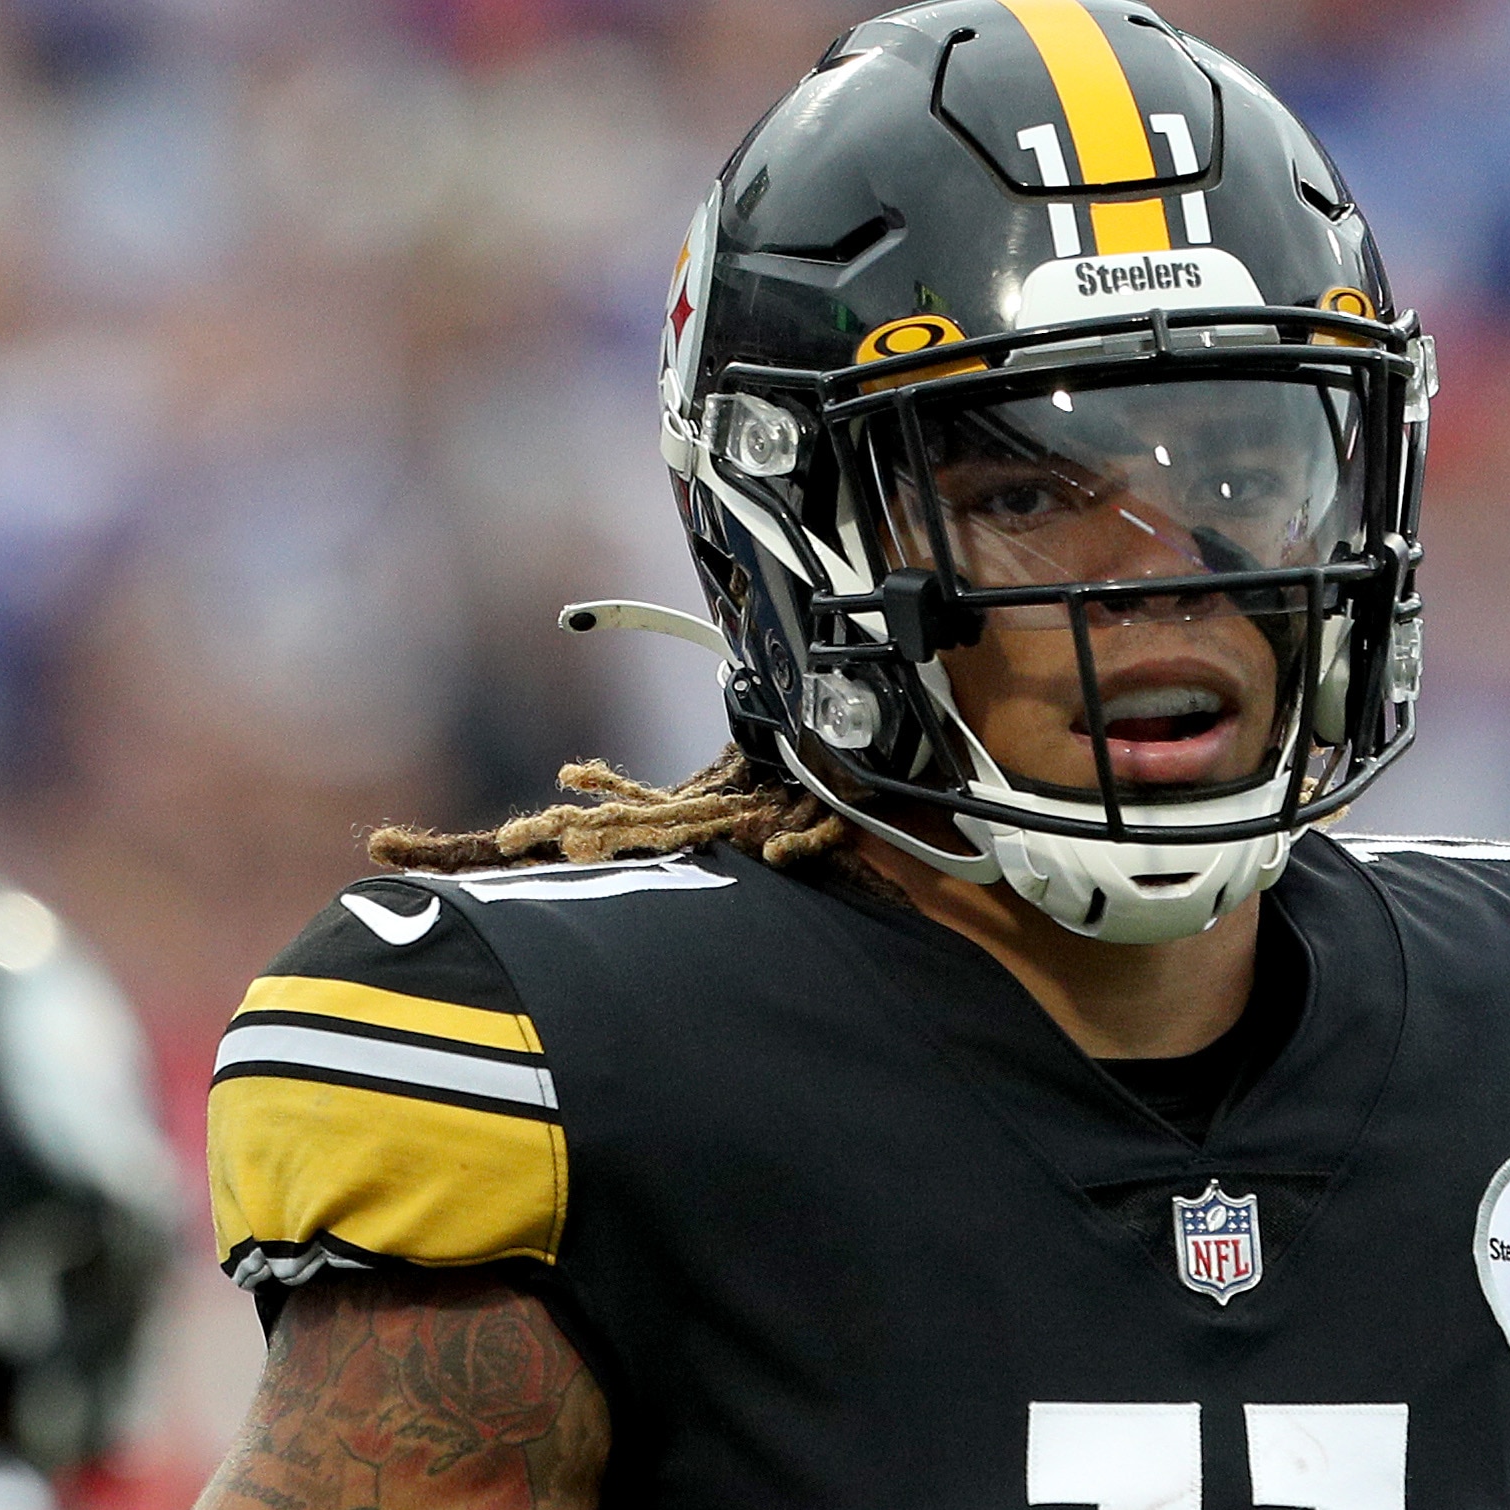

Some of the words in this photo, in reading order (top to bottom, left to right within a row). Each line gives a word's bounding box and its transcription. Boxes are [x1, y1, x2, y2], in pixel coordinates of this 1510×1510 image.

[1017, 113, 1212, 258] 11
[1076, 257, 1202, 297] Steelers
[1192, 1238, 1250, 1282] NFL
